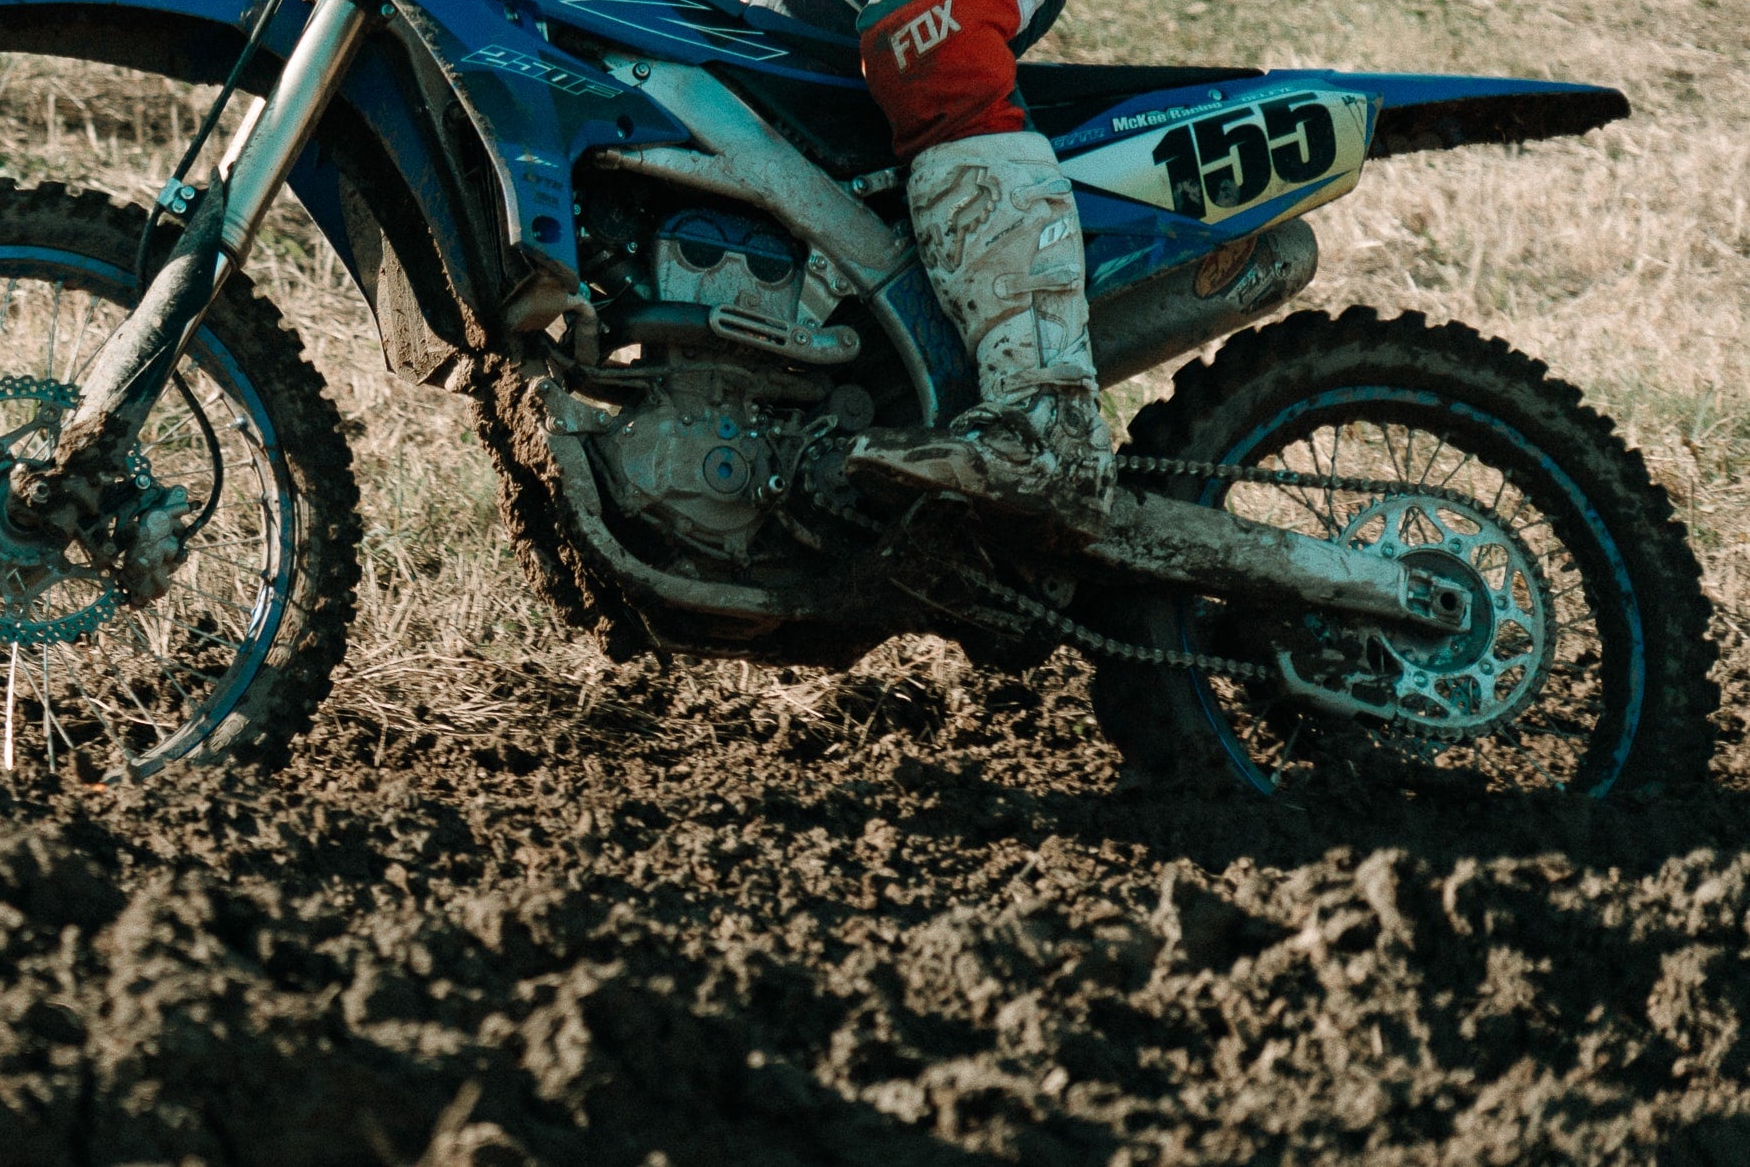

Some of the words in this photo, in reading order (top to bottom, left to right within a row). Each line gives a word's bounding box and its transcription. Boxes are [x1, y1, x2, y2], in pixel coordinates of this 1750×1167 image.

[460, 44, 624, 99] 250F
[1112, 112, 1167, 132] McKee
[1169, 101, 1223, 120] Racing
[1152, 91, 1337, 220] 155
